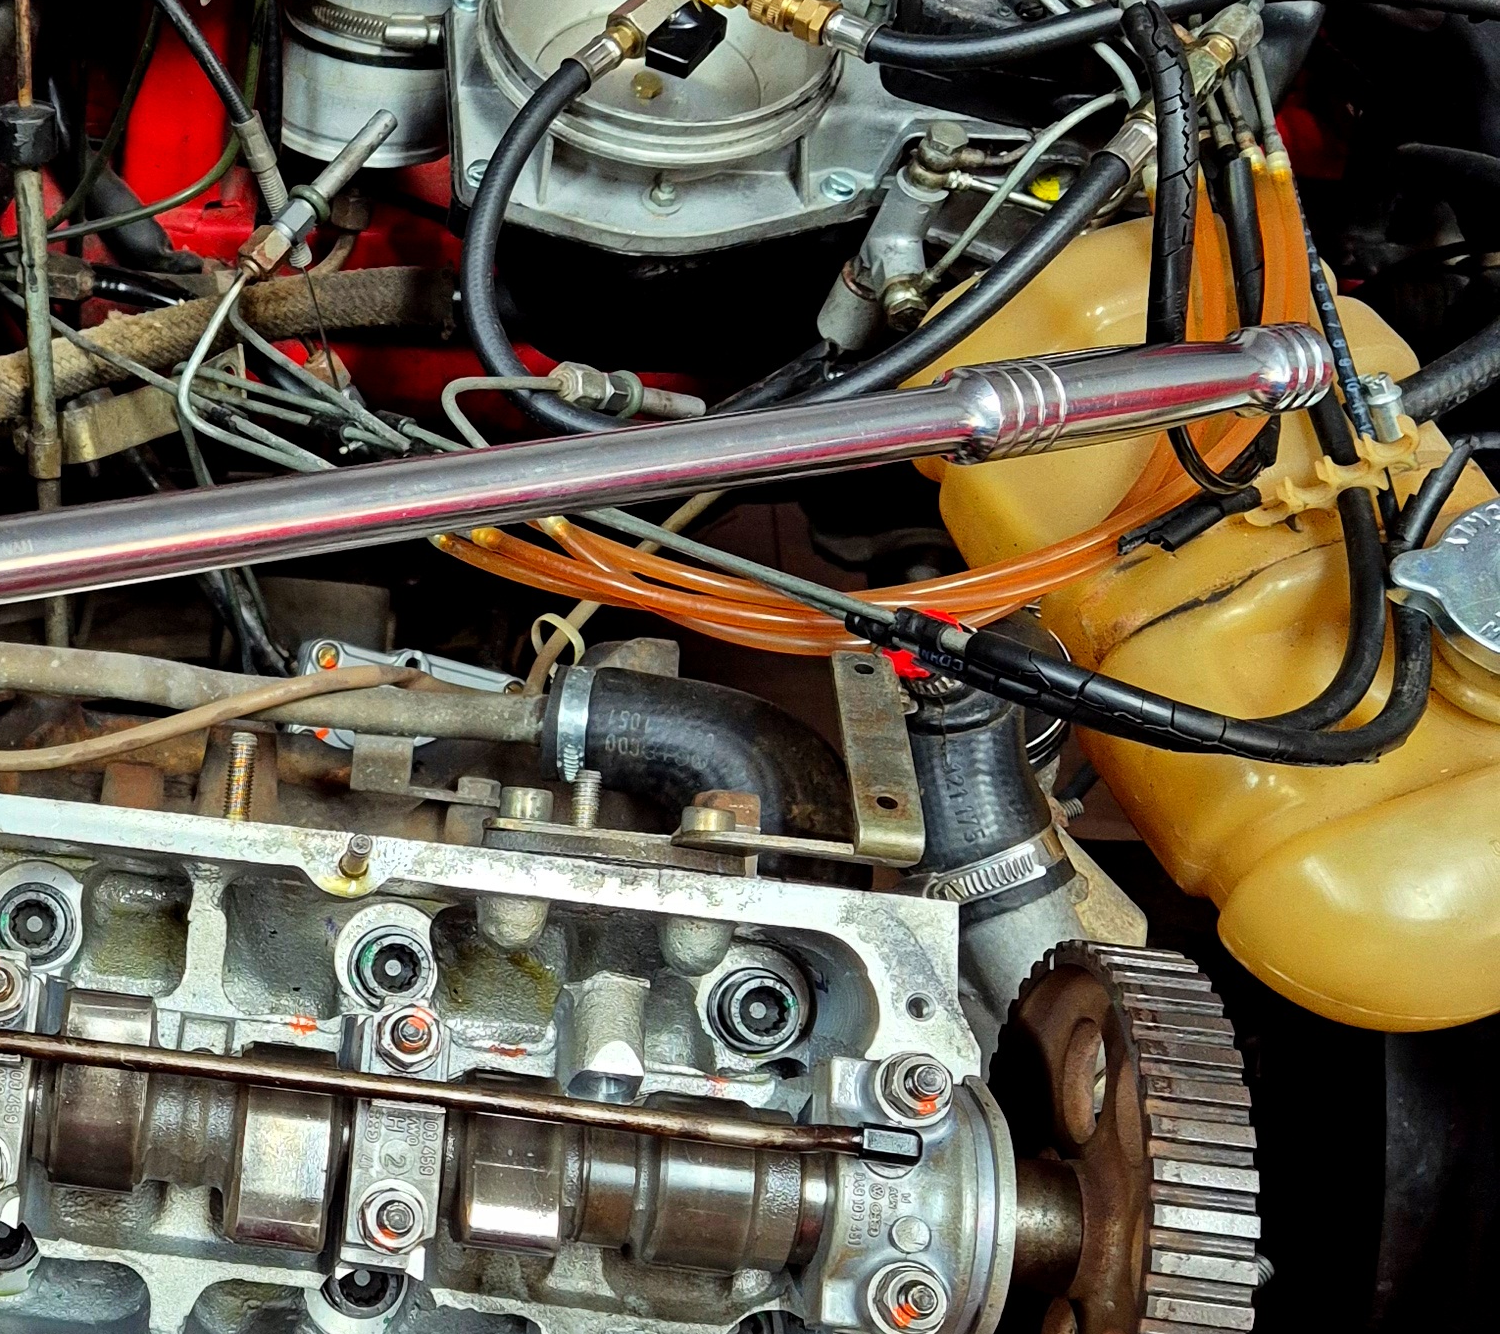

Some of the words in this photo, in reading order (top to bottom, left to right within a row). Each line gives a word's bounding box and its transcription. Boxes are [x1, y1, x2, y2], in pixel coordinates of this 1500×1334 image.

[1333, 339, 1346, 348] 8
[1339, 358, 1352, 367] 9
[1345, 377, 1360, 391] 10
[384, 1153, 405, 1168] 2
